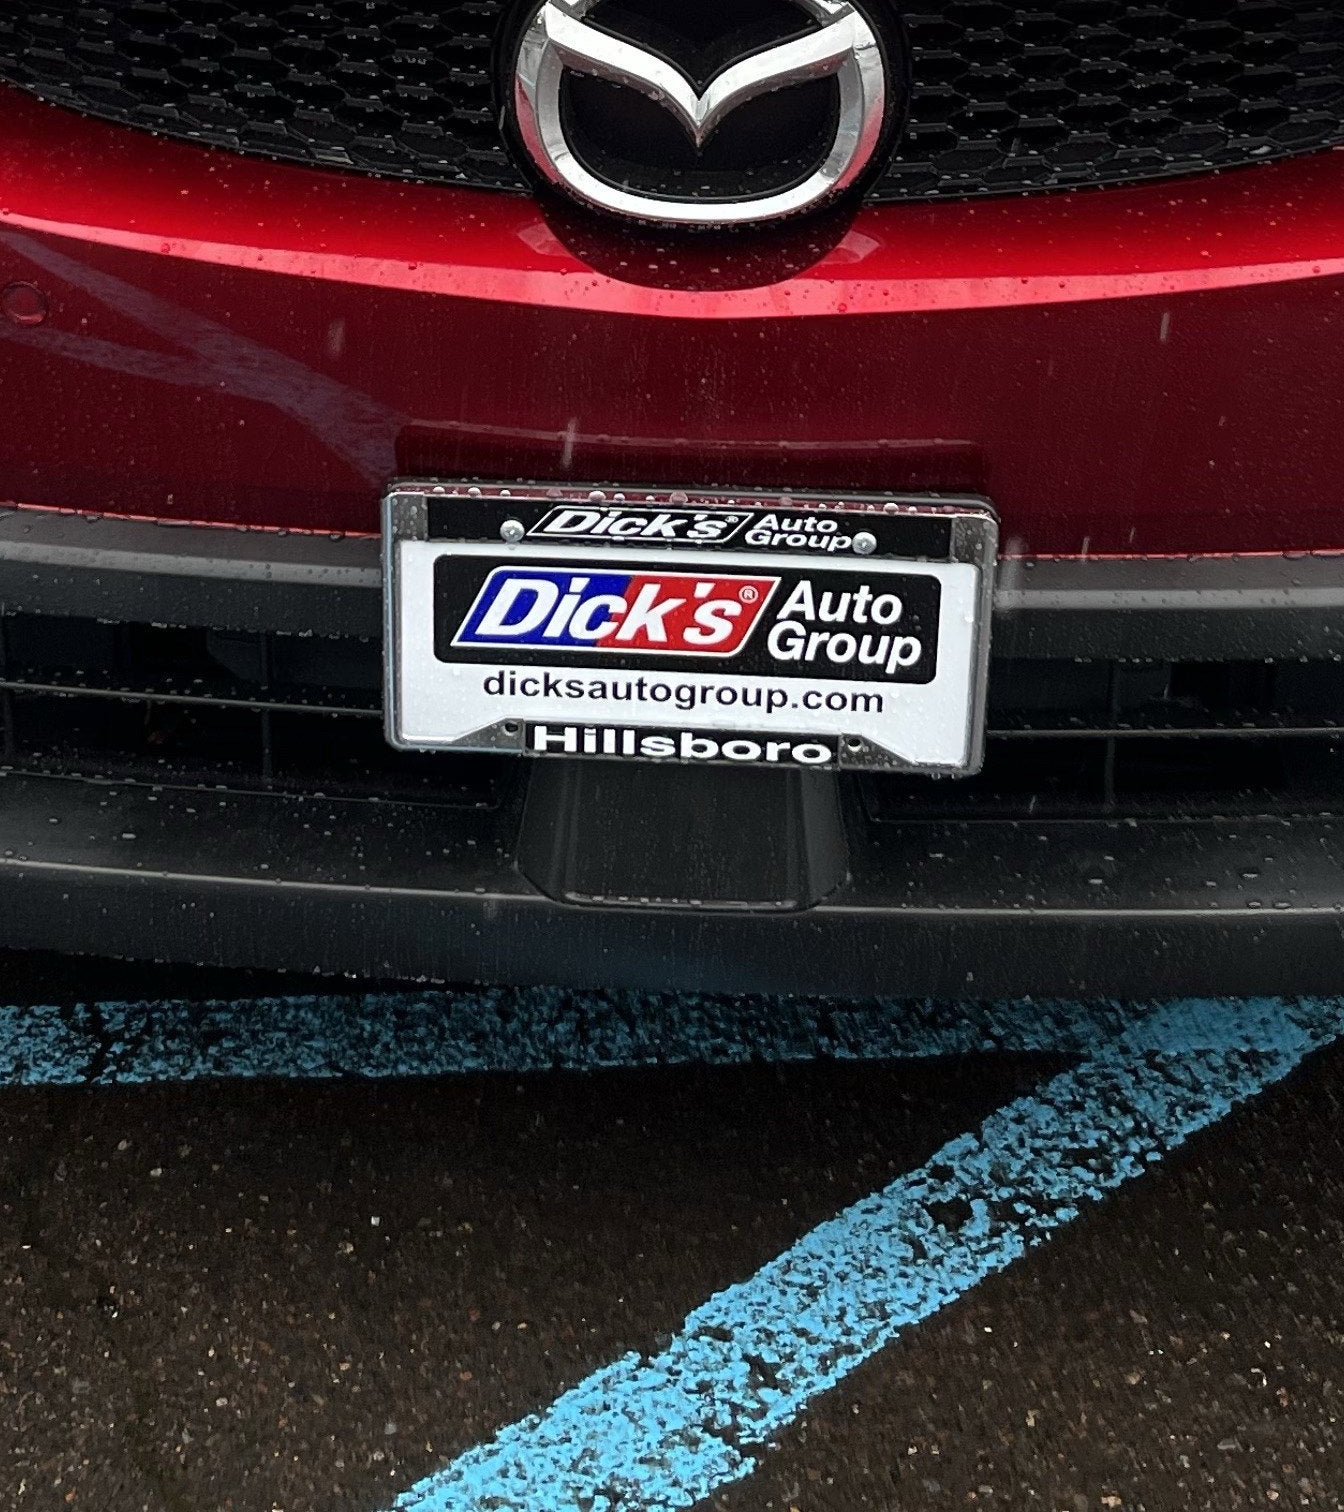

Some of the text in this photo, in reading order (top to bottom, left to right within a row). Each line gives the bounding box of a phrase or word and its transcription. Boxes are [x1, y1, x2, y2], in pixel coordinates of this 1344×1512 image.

[542, 508, 728, 541] Dick's
[745, 530, 852, 553] Group
[753, 514, 838, 534] Auto
[474, 577, 744, 645] Dick's
[775, 580, 903, 624] Auto
[766, 621, 921, 676] Group
[482, 670, 885, 714] dicksautogroup.com
[533, 724, 833, 765] Hillsboro
